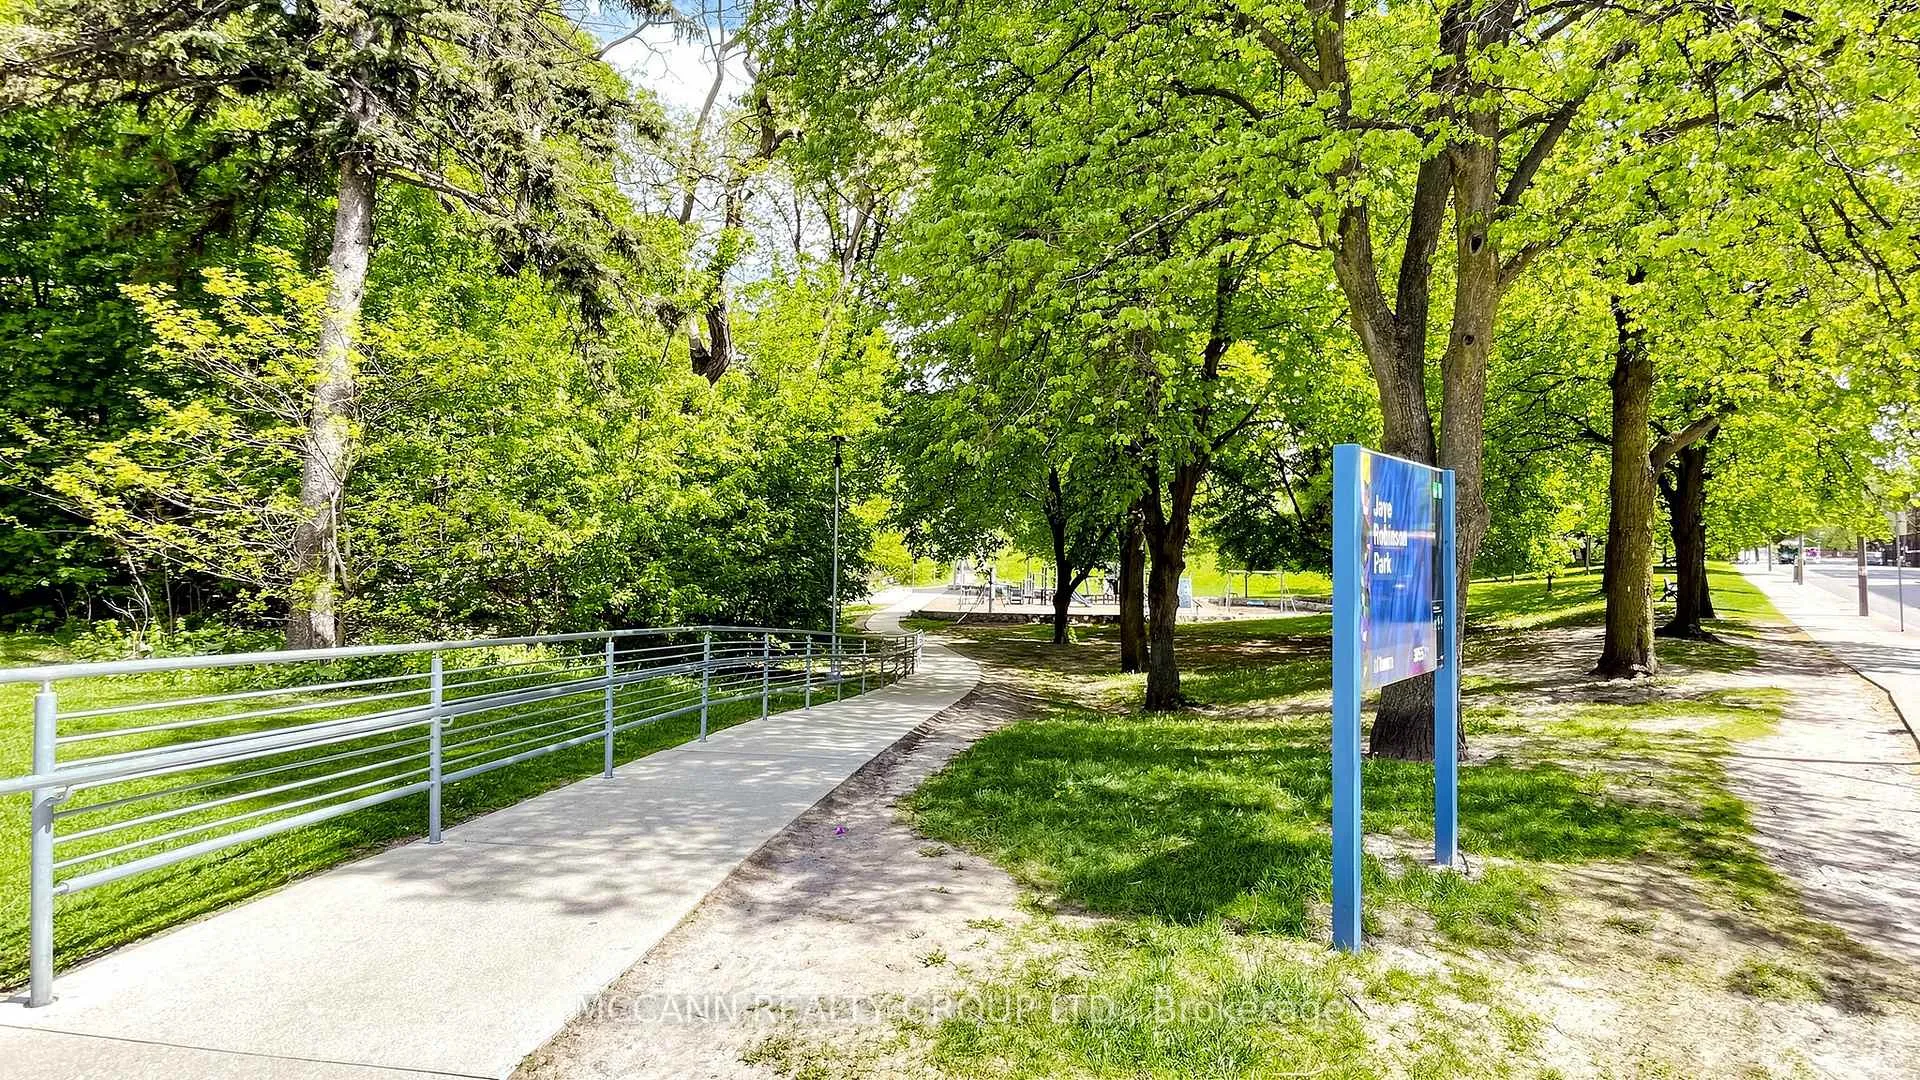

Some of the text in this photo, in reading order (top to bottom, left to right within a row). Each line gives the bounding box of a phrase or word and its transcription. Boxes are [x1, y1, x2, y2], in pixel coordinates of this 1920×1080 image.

[1373, 494, 1392, 523] Jaye
[1373, 522, 1407, 546] Robinson
[1373, 552, 1392, 574] Park
